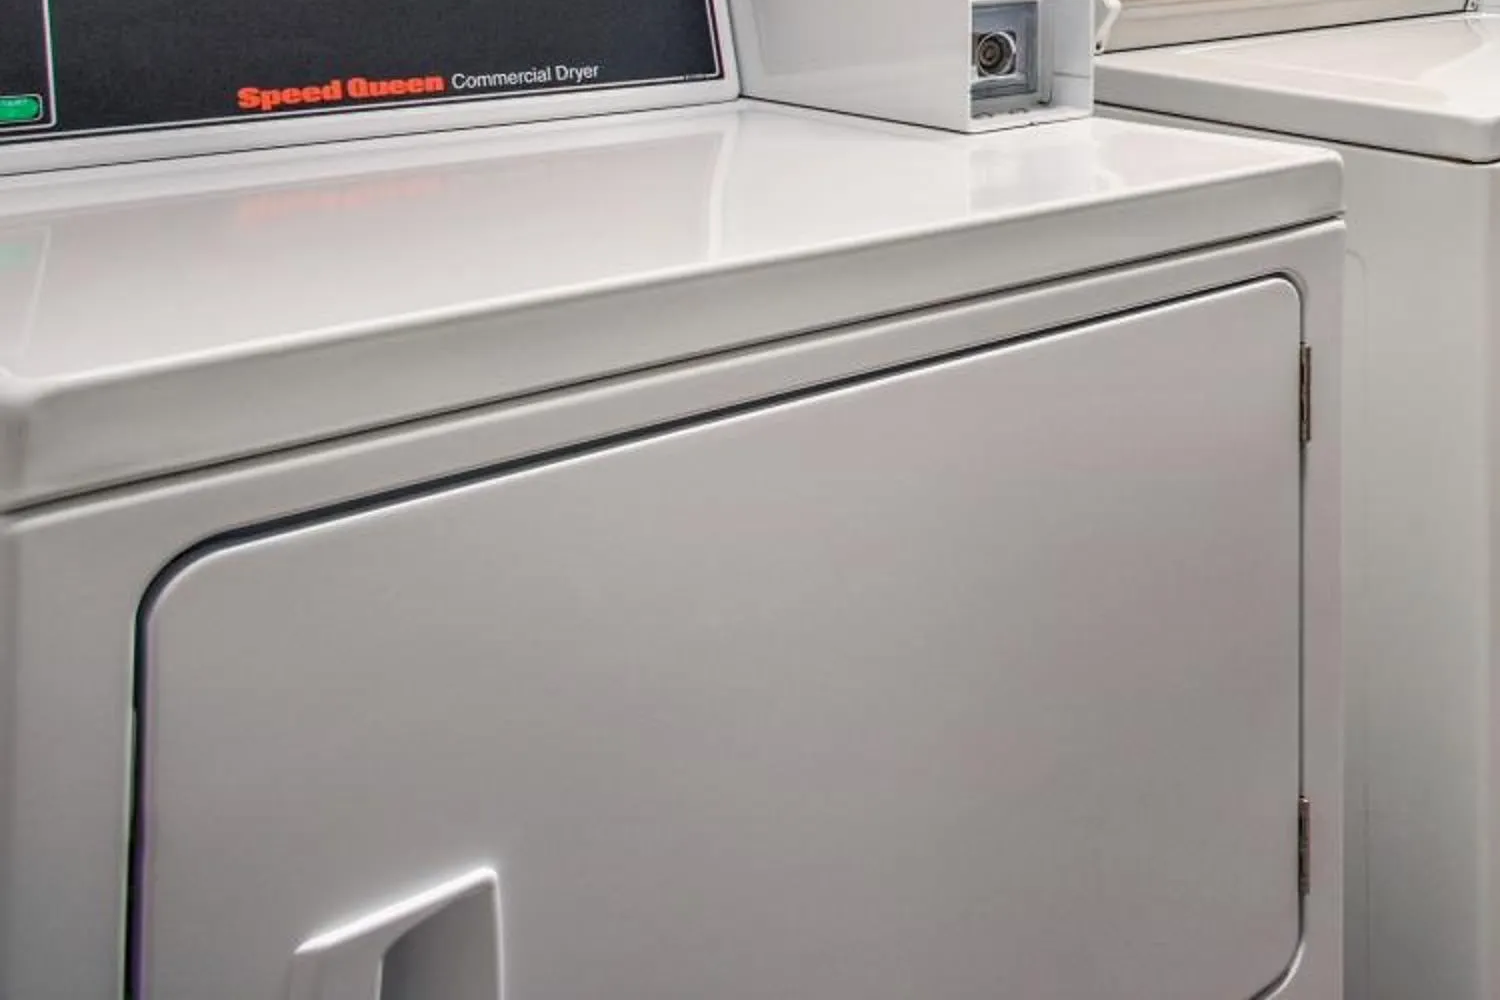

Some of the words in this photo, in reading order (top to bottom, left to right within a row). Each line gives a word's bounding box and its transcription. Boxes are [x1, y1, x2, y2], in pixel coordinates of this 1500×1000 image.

[237, 79, 342, 110] Speed
[347, 75, 445, 98] Queen
[451, 66, 551, 90] Commercial
[555, 65, 600, 84] Dryer
